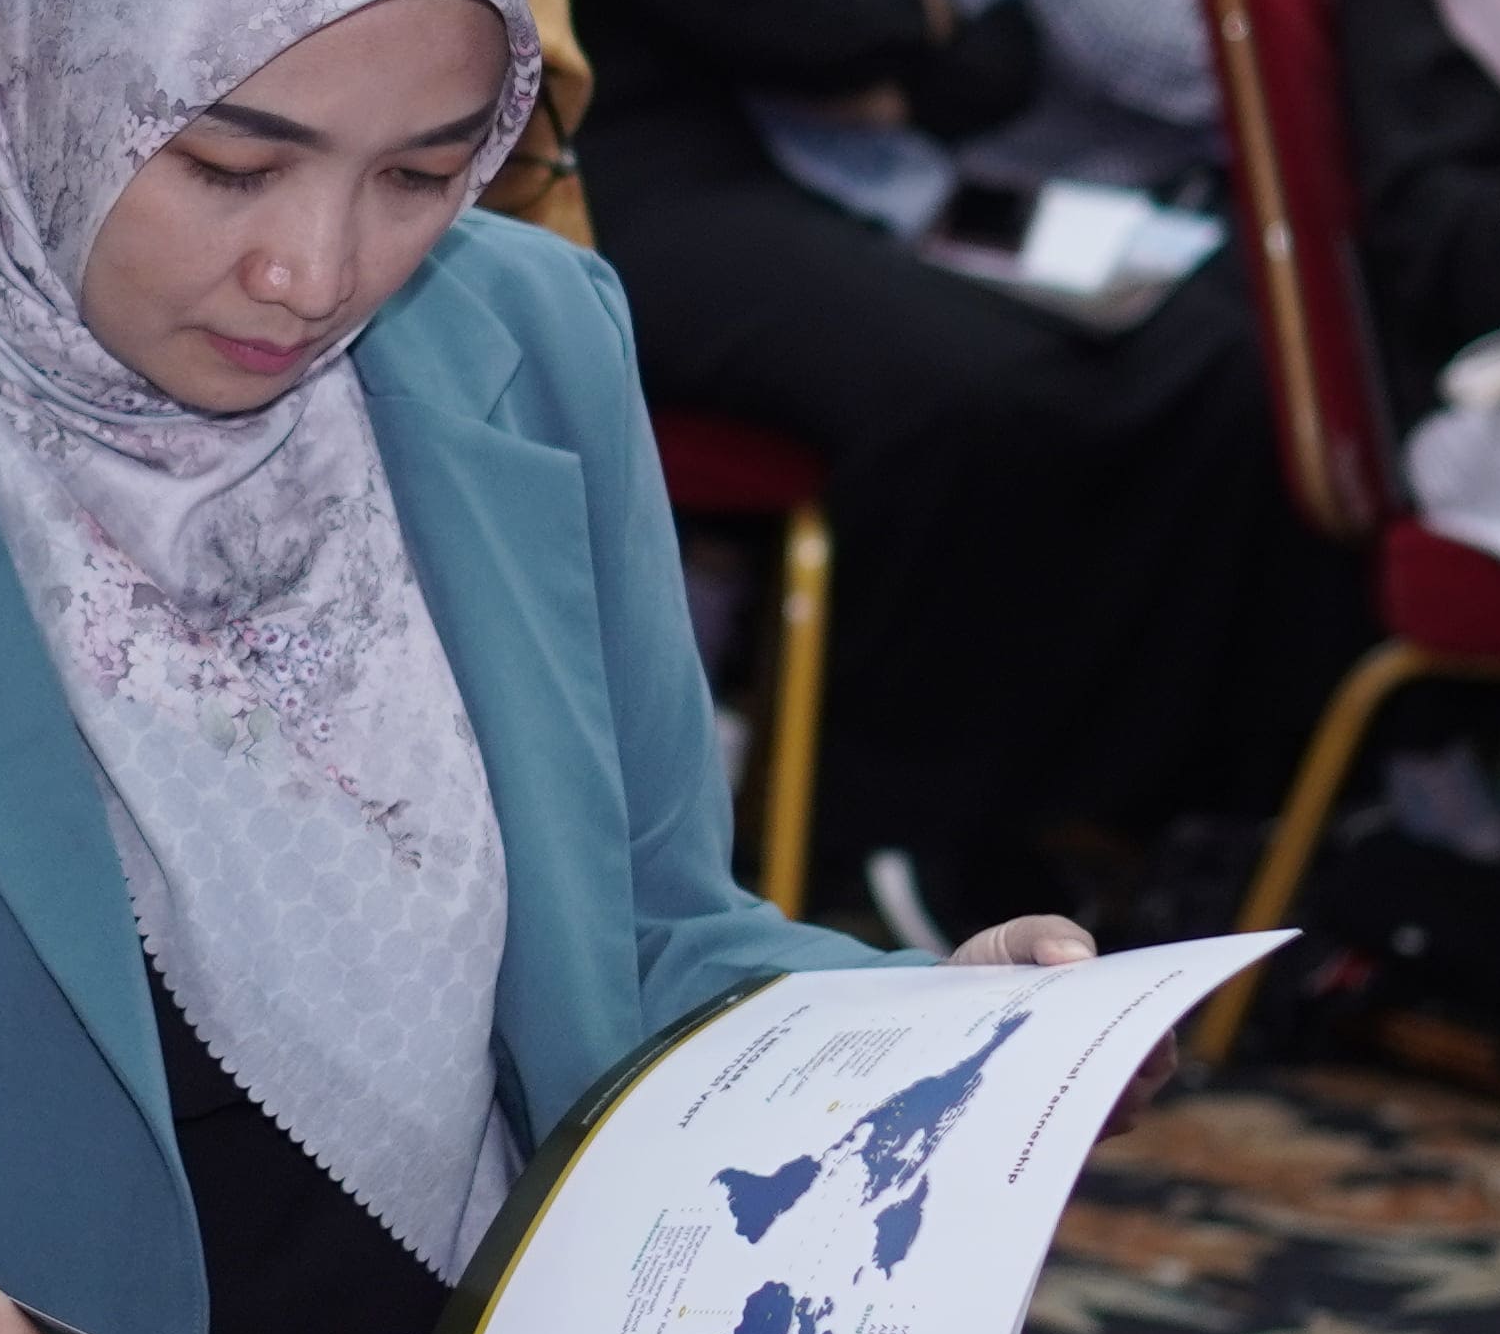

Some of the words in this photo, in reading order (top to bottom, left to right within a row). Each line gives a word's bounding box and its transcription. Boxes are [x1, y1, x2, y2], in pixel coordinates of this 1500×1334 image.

[1154, 969, 1184, 988] Our
[1066, 991, 1153, 1080] International
[719, 1037, 779, 1092] NEGARA
[1007, 1084, 1069, 1184] Partnership
[867, 1324, 877, 1334] Al
[878, 1324, 888, 1334] Al
[889, 1324, 899, 1334] Al
